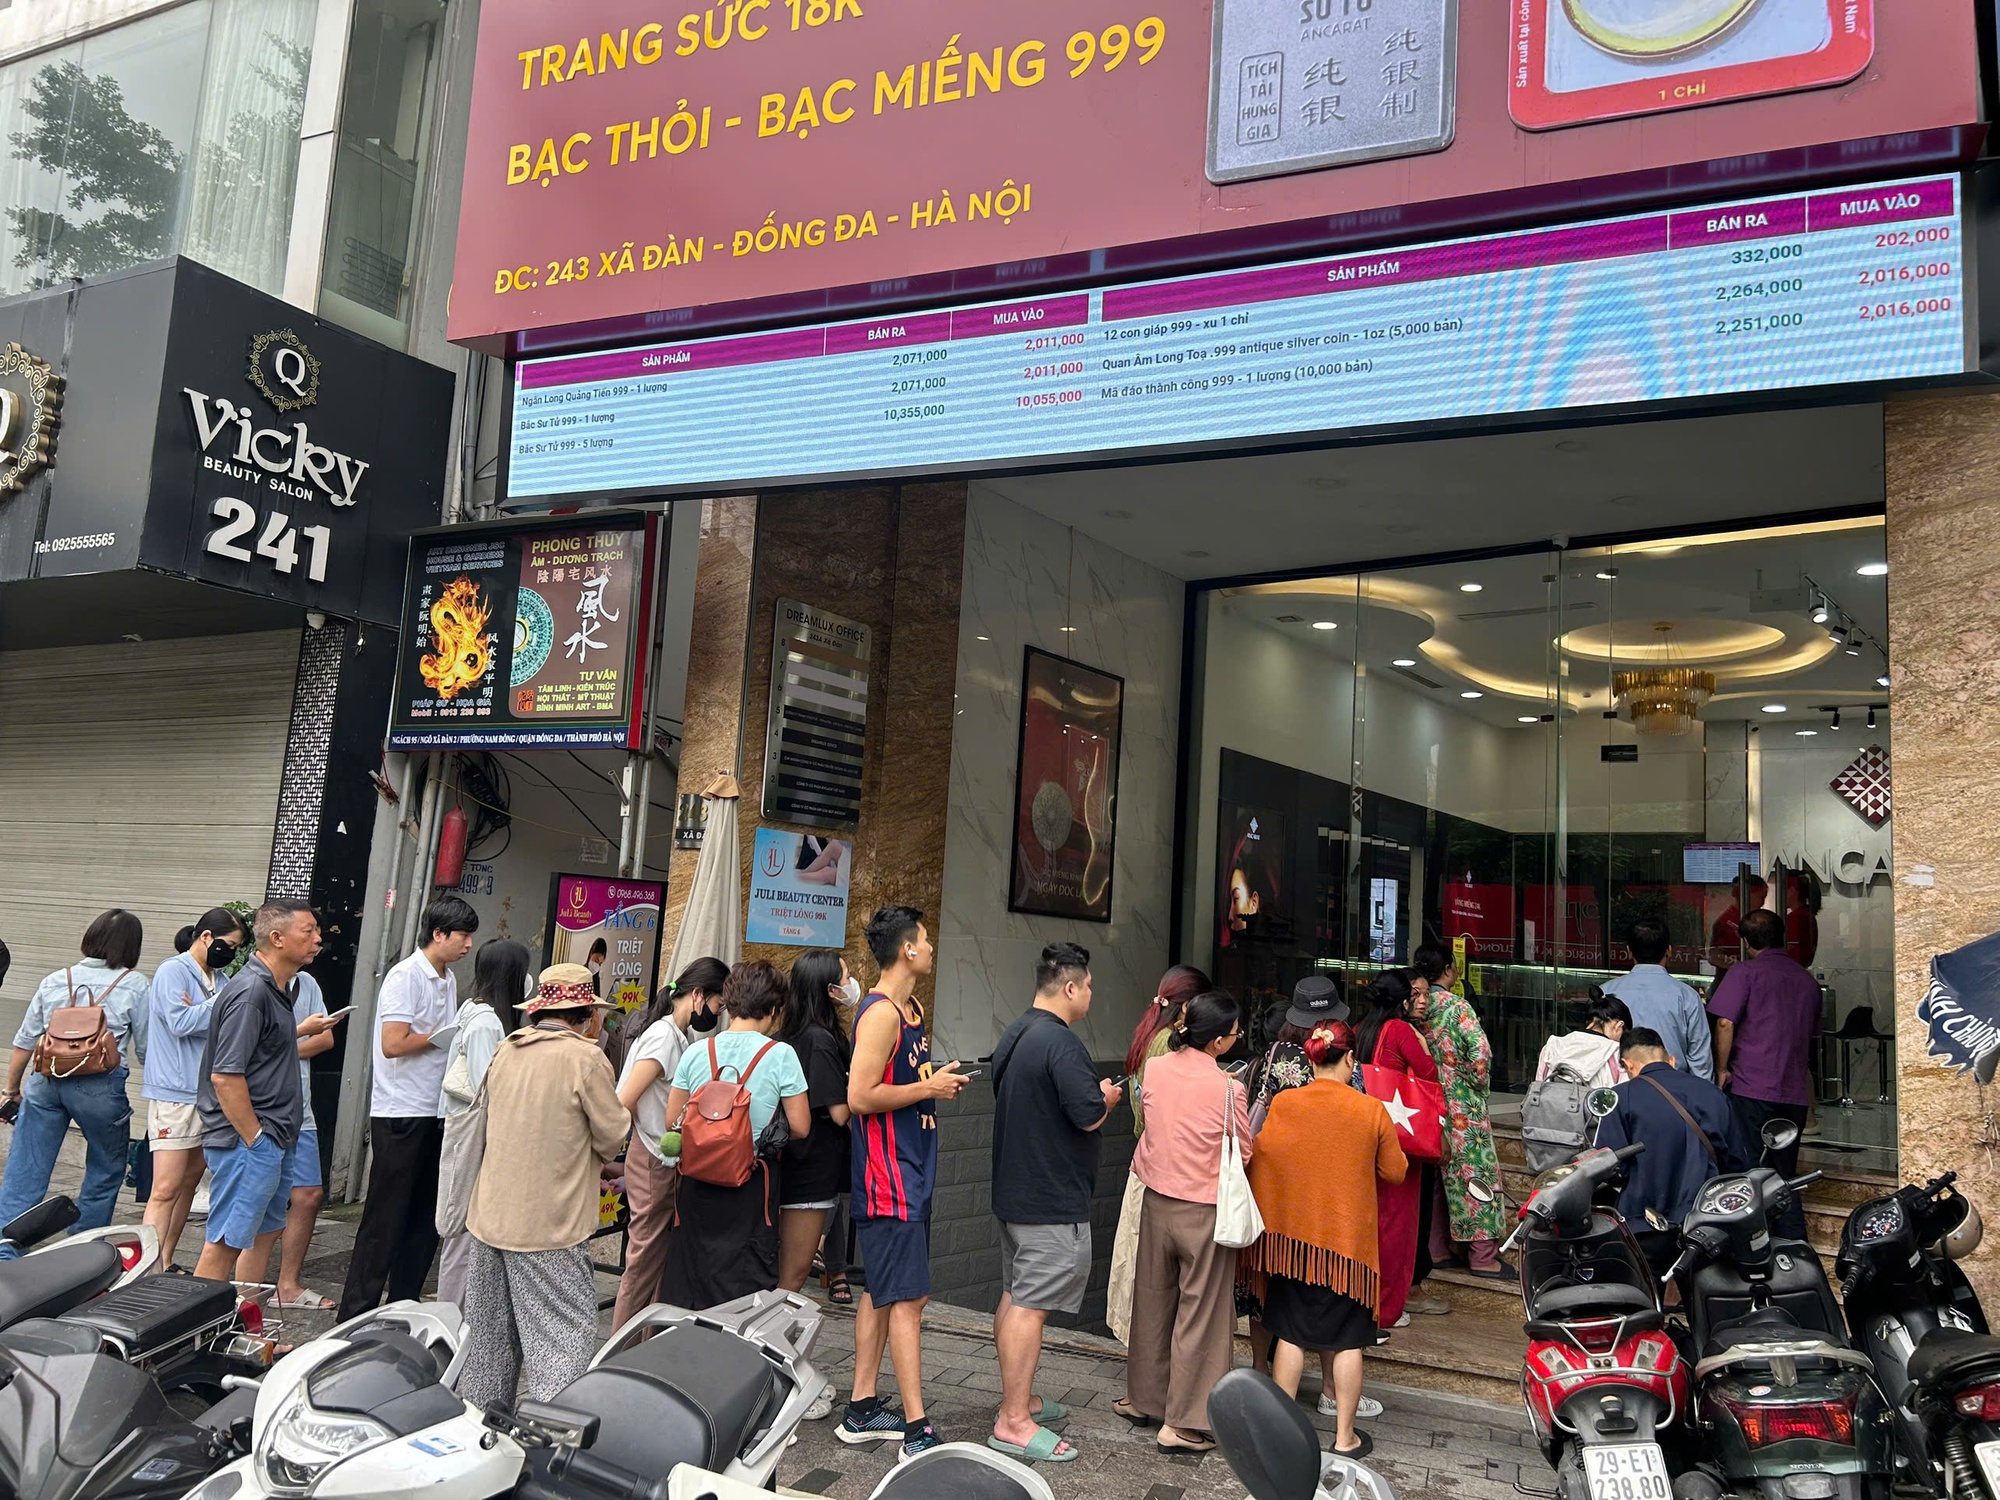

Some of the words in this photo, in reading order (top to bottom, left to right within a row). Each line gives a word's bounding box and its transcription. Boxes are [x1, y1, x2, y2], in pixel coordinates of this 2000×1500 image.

[1845, 3, 1859, 33] Nam
[1300, 16, 1372, 42] ANCARAT
[518, 22, 663, 90] TRANG
[1517, 40, 1529, 65] xuất
[1247, 57, 1277, 79] TÍCH
[1515, 65, 1528, 87] Sản
[1250, 79, 1273, 98] TÀI
[1658, 89, 1667, 101] 1
[507, 132, 592, 187] BẠC
[605, 98, 712, 166] THỎI
[757, 78, 857, 139] BẠC
[873, 33, 1046, 115] MIẾNG
[1065, 16, 1166, 79] 999
[1246, 124, 1270, 141] GIA
[1840, 201, 1880, 216] MUA
[1882, 193, 1921, 211] VÀO
[1706, 215, 1741, 233] BÁN
[1745, 212, 1768, 228] RA
[495, 267, 539, 294] ĐC:
[545, 256, 589, 286] 243
[597, 242, 635, 278] XÃ
[642, 234, 704, 271] ĐÀN
[732, 211, 826, 257] ĐỐNG
[834, 210, 878, 242] ĐA
[911, 189, 957, 229] HÀ
[967, 179, 1032, 225] NỘI
[1875, 227, 1950, 248] 202,000
[1731, 244, 1803, 265] 332,000
[1327, 268, 1355, 283] SẢN
[1358, 259, 1400, 279] PHẨM
[1859, 262, 1951, 286] 2,016,000
[1715, 278, 1803, 301] 2,264,000
[993, 312, 1019, 325] MUA
[1020, 306, 1044, 323] VÀO
[1859, 297, 1951, 321] 2,016,000
[868, 327, 889, 341] BÁN
[892, 325, 906, 338] RA
[1104, 329, 1118, 341] 12
[1120, 329, 1140, 338] con
[1143, 322, 1168, 337] giáp
[1171, 320, 1192, 332] 999
[1203, 320, 1217, 328] xu
[1715, 312, 1803, 335] 2,251,000
[1025, 333, 1085, 352] 2,011,000
[1102, 358, 1131, 371] Quan
[1134, 352, 1153, 367] Âm
[1155, 351, 1184, 367] Long
[1210, 344, 1236, 357] .999
[1239, 340, 1283, 356] antique
[1287, 334, 1320, 349] silver
[1323, 331, 1350, 344] coin
[1362, 328, 1385, 341] 1oz
[1388, 320, 1430, 341] (5,000
[642, 353, 660, 367] SẢN
[662, 350, 691, 365] PHẨM
[893, 349, 947, 366] 2,071,000
[275, 348, 308, 397] Q
[1023, 361, 1083, 379] 2,011,000
[1101, 386, 1118, 399] Mã
[1121, 382, 1143, 396] đáo
[1145, 379, 1178, 394] thành
[1180, 377, 1209, 393] công
[1212, 373, 1234, 387] 999
[1256, 367, 1292, 384] lượng
[1294, 362, 1342, 381] (10,000
[544, 393, 564, 404] Long
[613, 385, 629, 397] 999
[891, 376, 946, 394] 2,071,000
[1016, 390, 1082, 408] 10,055,000
[562, 416, 577, 426] 999
[884, 404, 945, 422] 10,355,000
[183, 387, 370, 507] Vicky
[561, 440, 576, 450] 999
[203, 456, 261, 485] BEAUTY
[269, 478, 313, 502] SALON
[34, 539, 51, 555] Tel:
[52, 532, 116, 552] 0925555565
[205, 496, 331, 583] 241
[532, 537, 580, 554] PHONG
[552, 554, 588, 565] DƯƠNG
[591, 551, 624, 563] TRẠCH
[786, 608, 834, 633] DREAMLUX
[836, 625, 865, 642] OFFICE
[555, 684, 572, 692] LINH
[617, 888, 655, 900] 0968.496.368
[755, 888, 775, 900] JULI
[777, 890, 811, 904] BEAUTY
[812, 894, 844, 907] CENTER
[647, 912, 655, 931] 6
[617, 937, 643, 958] TRIỆT
[611, 958, 642, 976] LÔNG
[622, 991, 639, 1003] 99K
[601, 1203, 615, 1214] 49K
[1595, 1449, 1652, 1475] 29-E1
[1789, 1463, 1825, 1471] HONDA
[1595, 1475, 1666, 1500] 238.80
